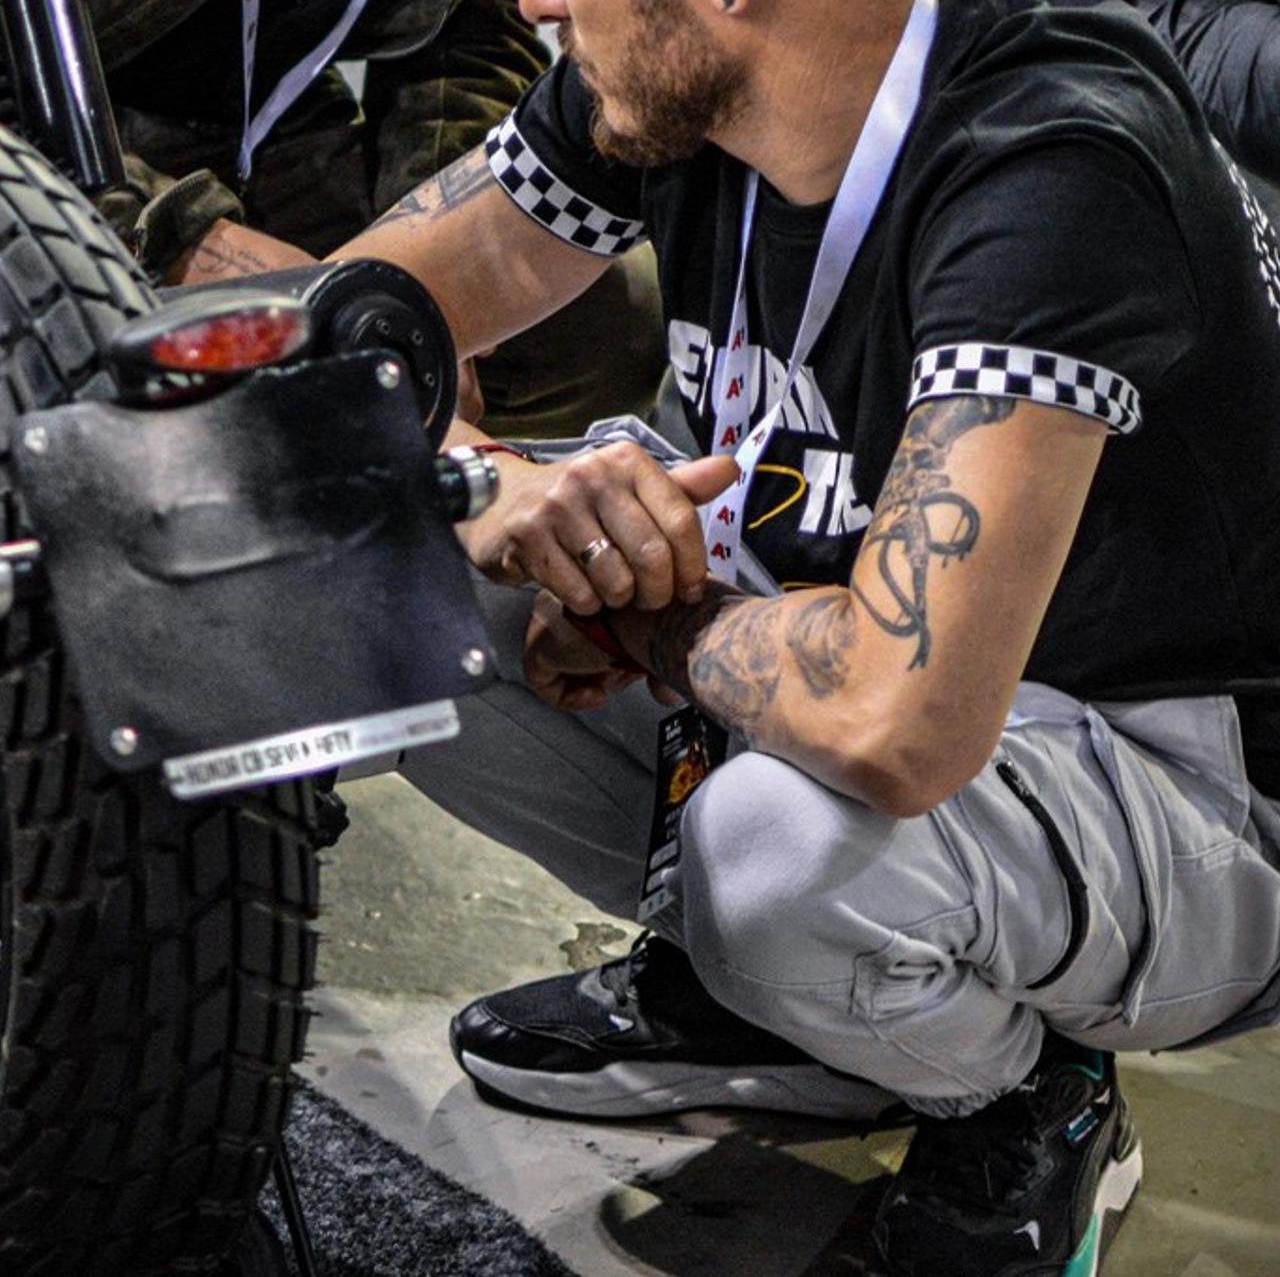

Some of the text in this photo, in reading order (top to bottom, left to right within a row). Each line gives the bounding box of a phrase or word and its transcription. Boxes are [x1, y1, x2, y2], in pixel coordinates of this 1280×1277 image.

[726, 374, 743, 399] A1
[720, 423, 741, 447] A1
[717, 505, 735, 526] A1
[710, 542, 731, 560] A1
